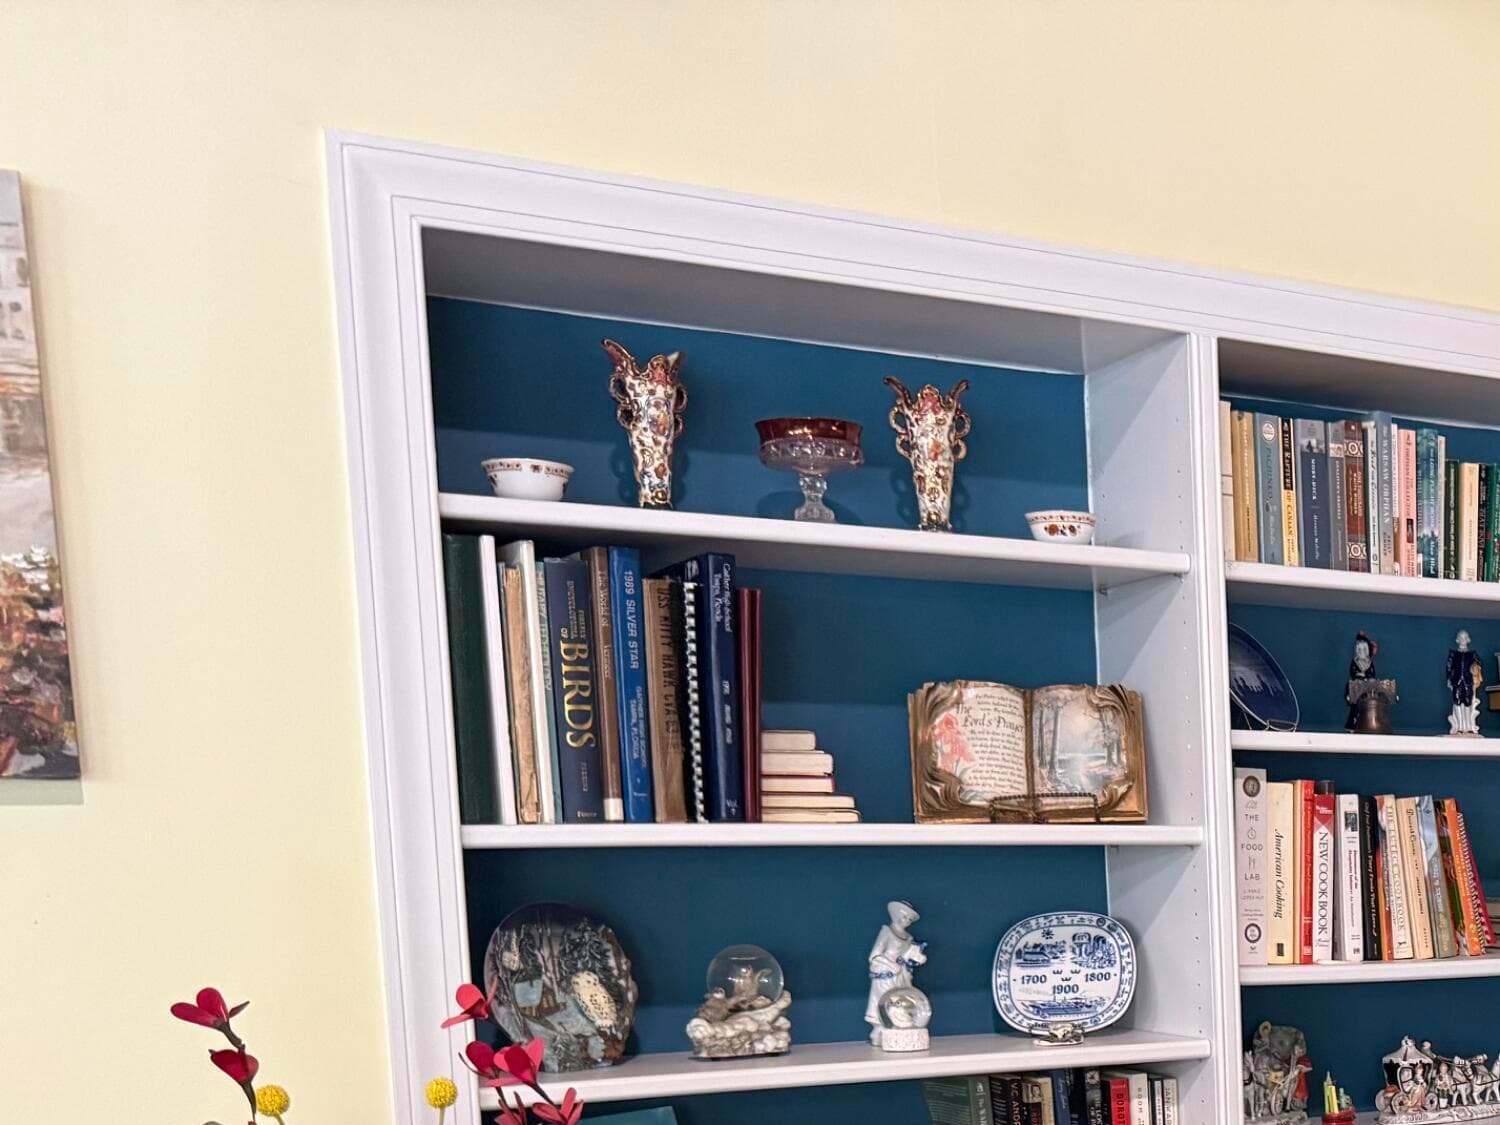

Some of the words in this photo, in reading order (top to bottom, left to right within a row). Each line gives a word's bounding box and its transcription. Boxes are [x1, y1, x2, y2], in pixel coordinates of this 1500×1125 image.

[1265, 447, 1273, 500] PACHINKO
[1284, 451, 1292, 489] RAPTURE
[1286, 492, 1293, 503] OF
[1382, 484, 1390, 524] ORPHAN
[598, 570, 608, 587] The
[624, 570, 635, 595] 1989
[599, 590, 609, 615] World
[656, 587, 673, 609] USS
[601, 617, 609, 628] of
[626, 599, 638, 637] SILVER
[560, 627, 569, 639] OF
[659, 615, 676, 648] KITTY
[628, 641, 640, 669] STAR
[662, 654, 679, 688] HAWK
[559, 641, 597, 748] BIRDS
[956, 704, 972, 715] The
[962, 713, 993, 728] Lord's
[996, 717, 1025, 733] Prayer
[631, 727, 640, 759] FLORIDA
[1245, 814, 1259, 822] THE
[1274, 829, 1284, 878] American
[1318, 832, 1329, 862] NEW
[1244, 873, 1261, 881] LAB
[1318, 863, 1329, 899] COOK
[1273, 879, 1285, 919] Cooking
[1318, 901, 1329, 935] BOOK
[1021, 974, 1047, 985] 1700
[1053, 984, 1080, 994] 1900
[1084, 972, 1111, 982] 1800
[1090, 1107, 1096, 1117] OF
